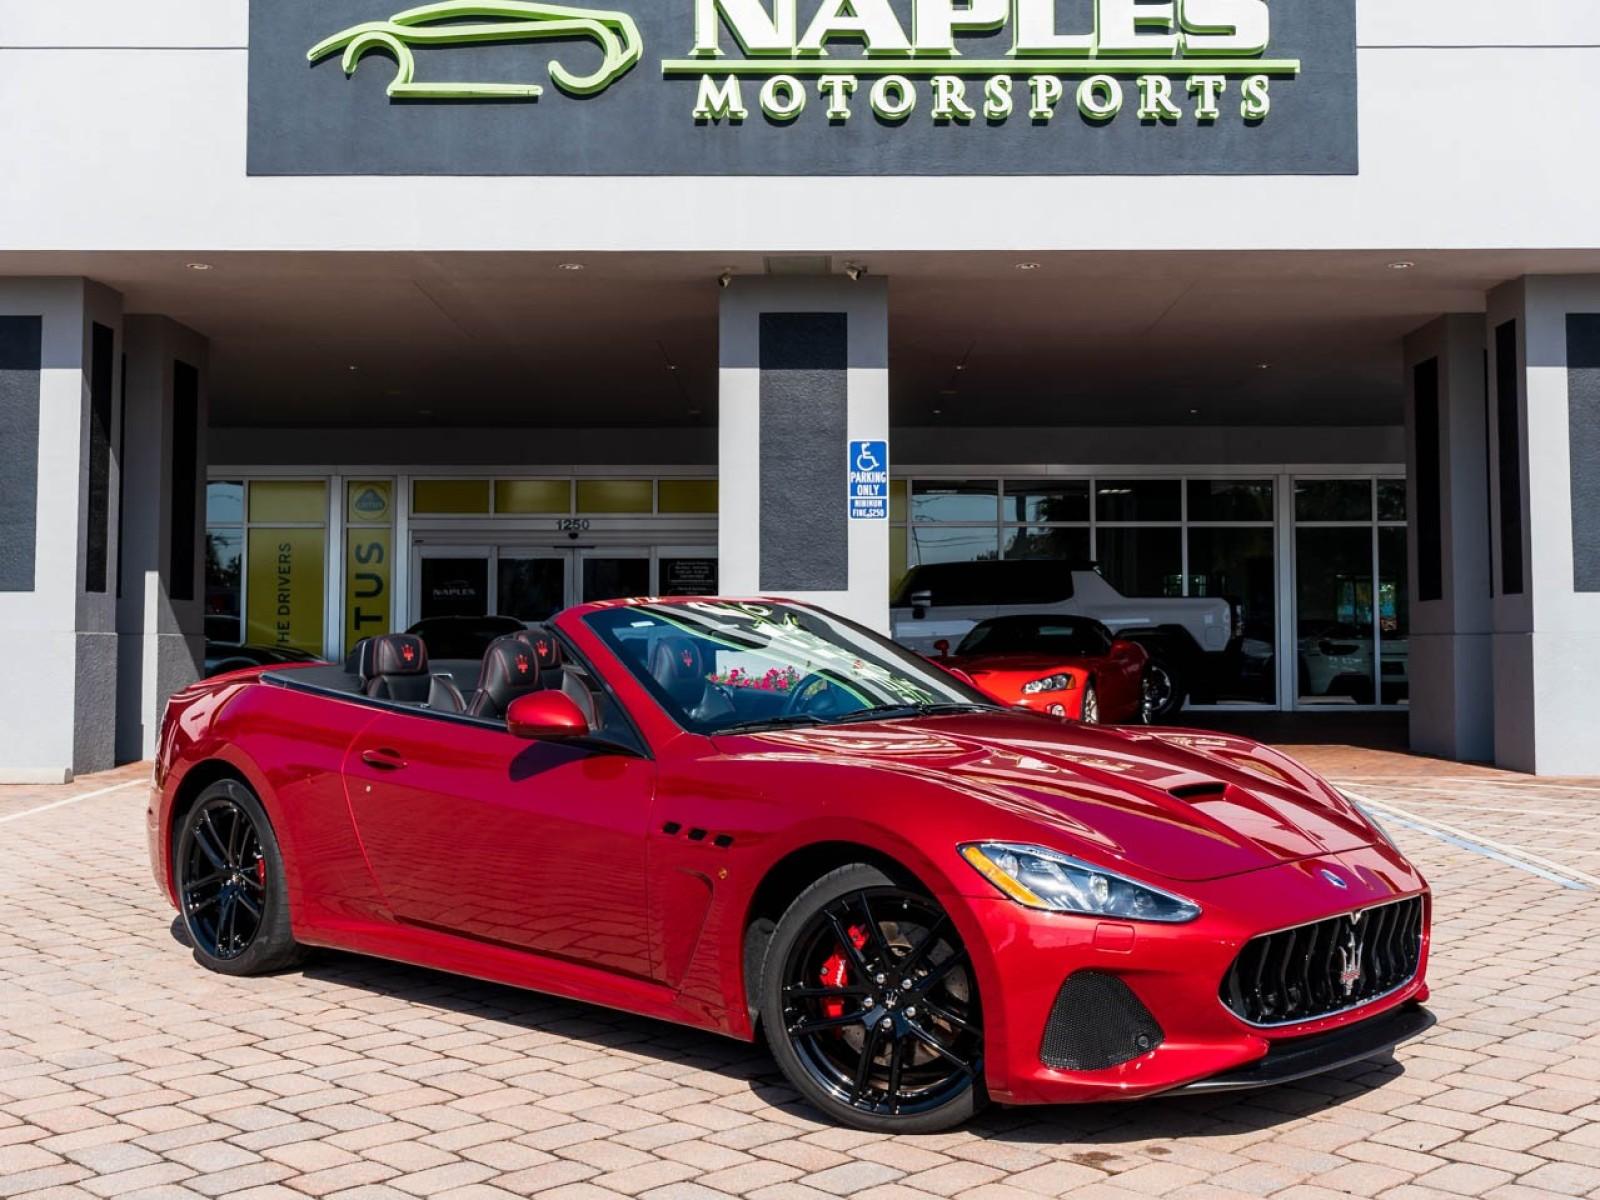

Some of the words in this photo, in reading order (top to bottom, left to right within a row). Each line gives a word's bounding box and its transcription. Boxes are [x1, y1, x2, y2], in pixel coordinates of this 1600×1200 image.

[688, 0, 1271, 57] NAPLES
[692, 73, 1271, 121] MOTORSPORTS
[850, 471, 887, 483] PARKING
[857, 484, 880, 496] ONLY
[556, 519, 590, 530] 1250
[278, 542, 291, 616] DRIVERS
[354, 542, 384, 642] TUS
[277, 621, 290, 643] HE
